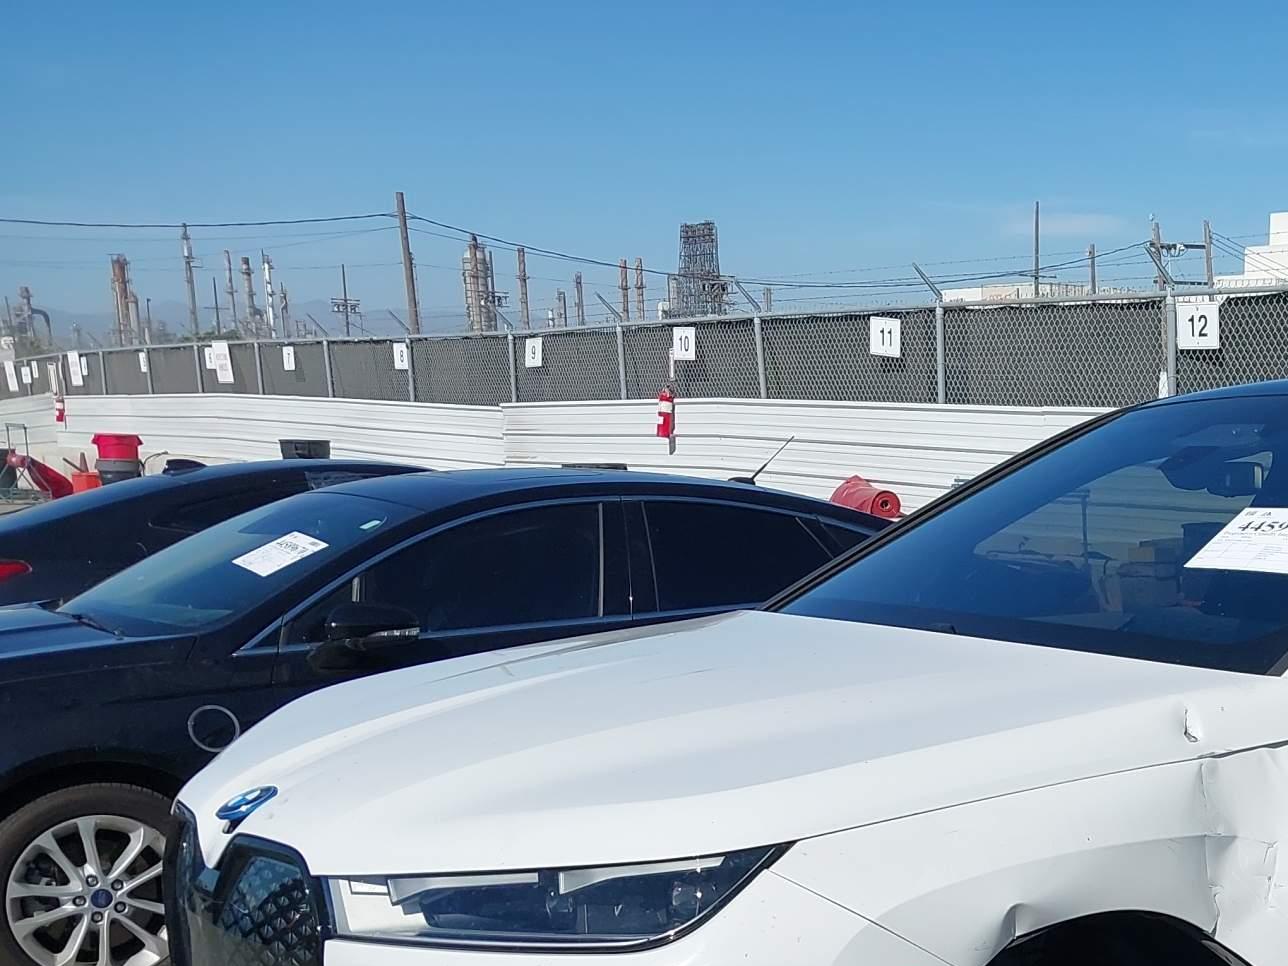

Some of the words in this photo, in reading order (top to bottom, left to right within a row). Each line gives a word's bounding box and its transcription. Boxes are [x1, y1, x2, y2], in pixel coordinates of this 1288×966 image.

[1187, 314, 1208, 337] 12
[678, 335, 690, 352] 10
[879, 327, 892, 346] 11
[399, 350, 405, 363] 8
[530, 345, 537, 360] 9
